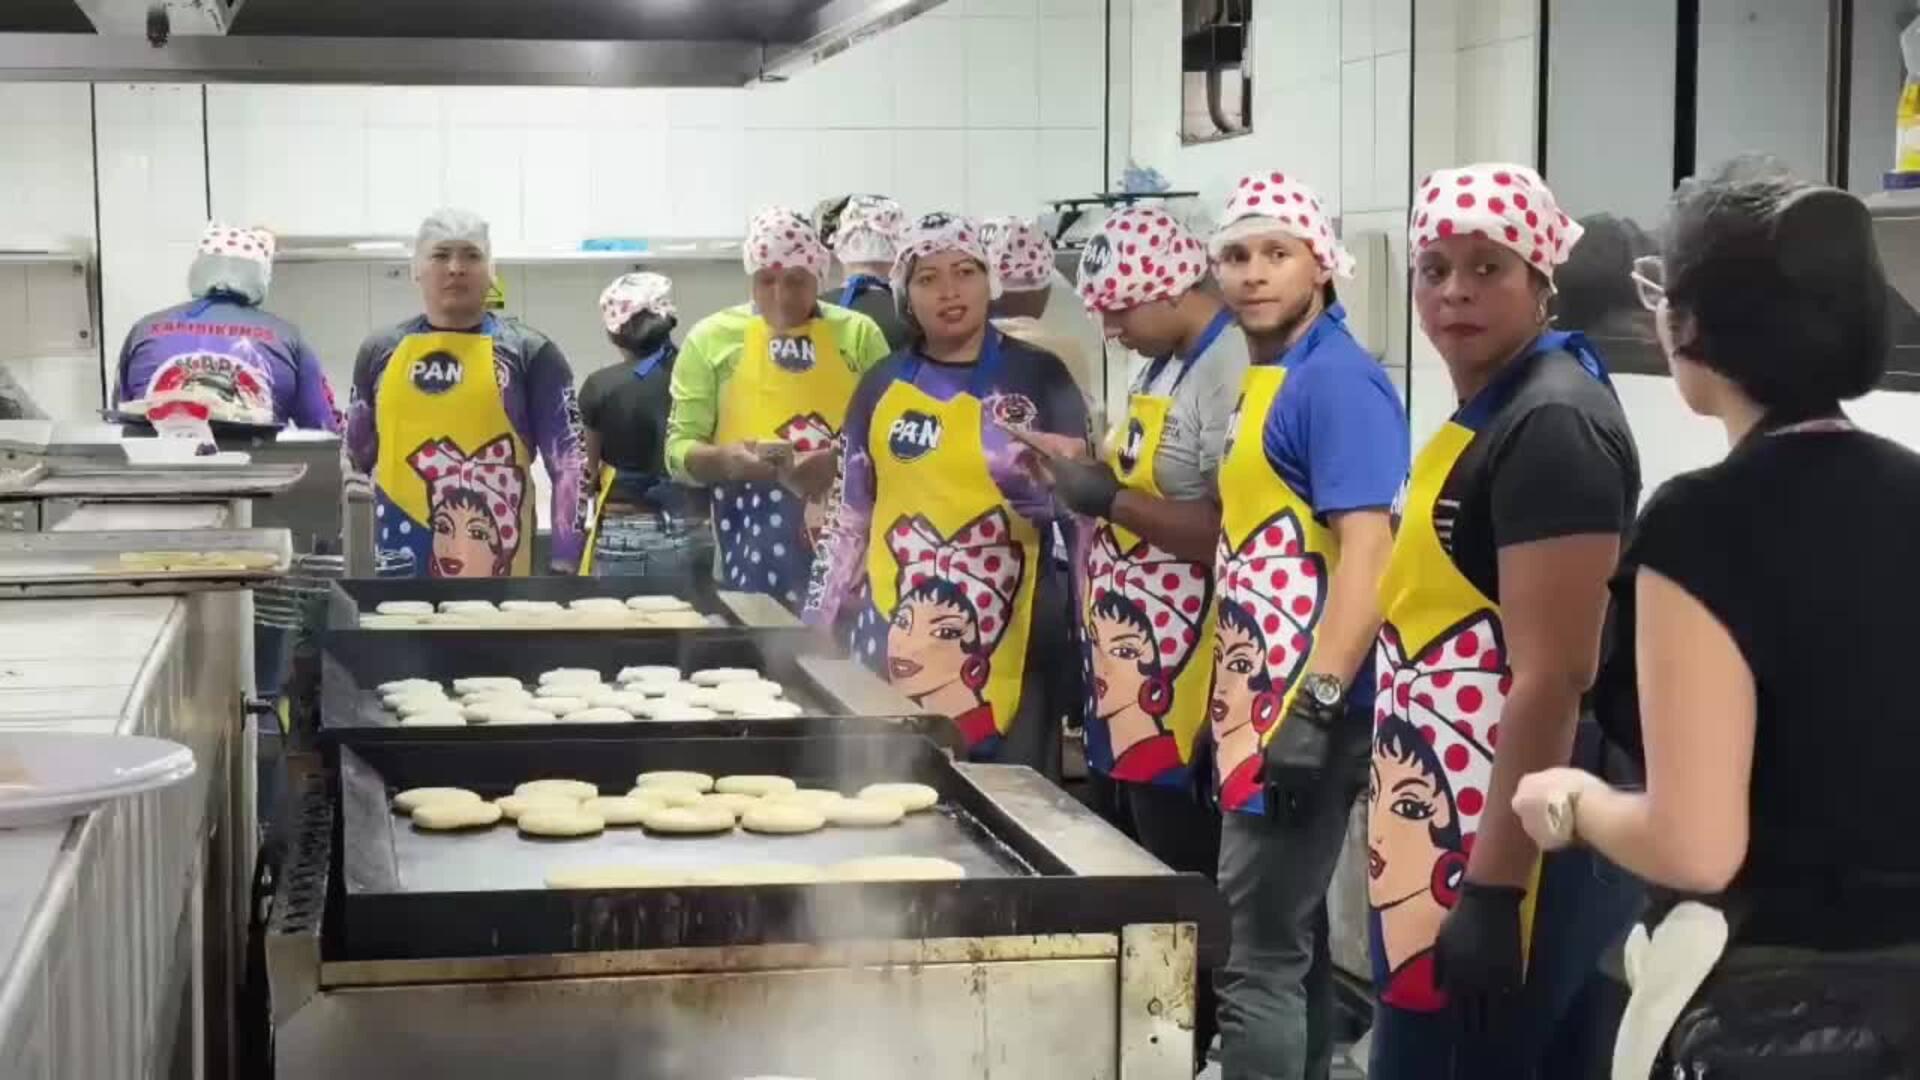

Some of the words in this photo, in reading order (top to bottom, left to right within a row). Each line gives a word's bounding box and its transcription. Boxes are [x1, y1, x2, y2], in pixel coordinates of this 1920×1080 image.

[769, 337, 816, 363] PAN
[409, 360, 463, 384] PAN
[888, 418, 941, 448] PAN
